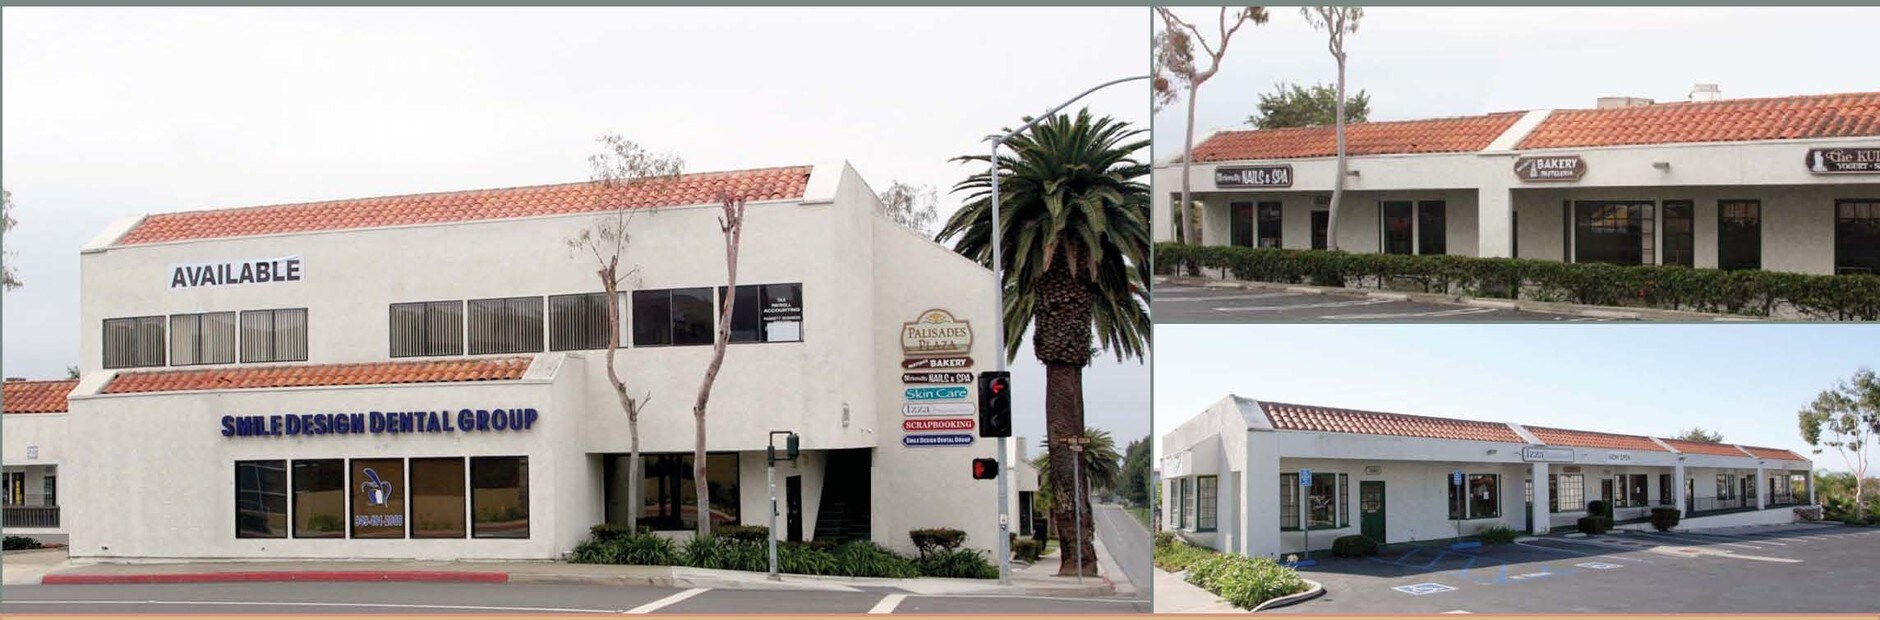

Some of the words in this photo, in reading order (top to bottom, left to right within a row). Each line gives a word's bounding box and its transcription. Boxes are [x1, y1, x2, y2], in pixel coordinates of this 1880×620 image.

[1537, 158, 1578, 169] BAKERY
[1836, 162, 1868, 170] YOGURT
[1241, 169, 1264, 184] NAILS
[1271, 168, 1288, 184] SPA
[171, 259, 301, 288] AVAILABLE
[908, 327, 967, 338] PALISADES
[919, 339, 956, 350] PLAZA
[929, 358, 966, 368] BAKERY
[928, 373, 950, 383] NAILS
[955, 372, 971, 383] SPA
[906, 389, 934, 399] Skin
[936, 388, 968, 398] Care
[221, 415, 282, 437] SMILE
[285, 413, 365, 435] DESIGN
[369, 411, 454, 434] DENTAL
[457, 408, 539, 432] GROUP
[905, 420, 972, 429] SCRAPBOOKING
